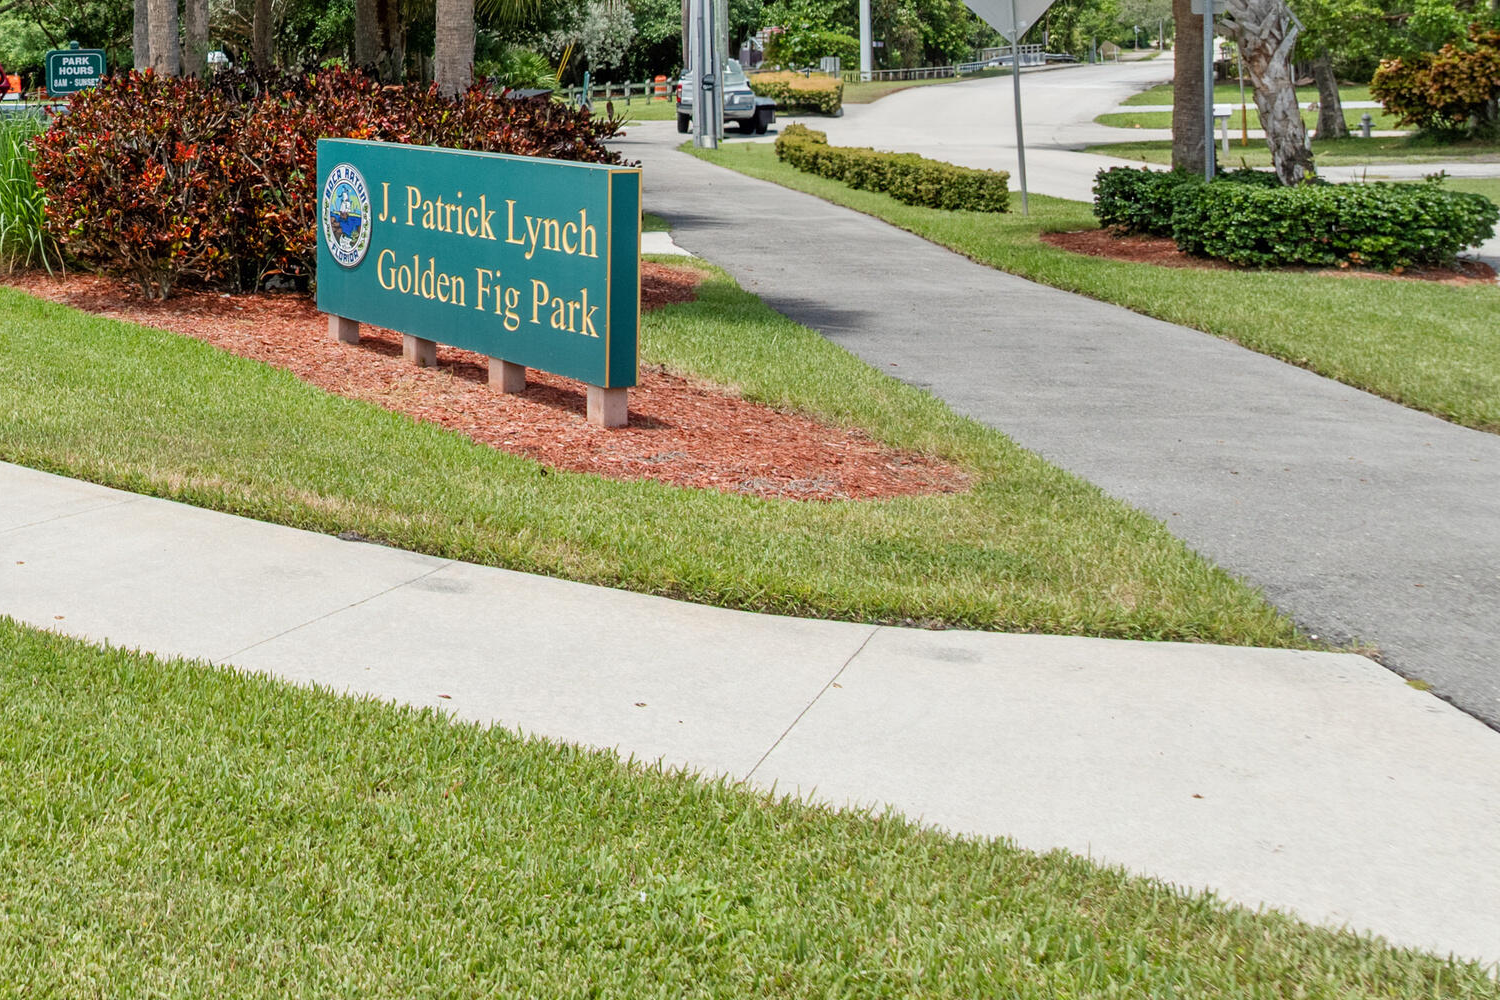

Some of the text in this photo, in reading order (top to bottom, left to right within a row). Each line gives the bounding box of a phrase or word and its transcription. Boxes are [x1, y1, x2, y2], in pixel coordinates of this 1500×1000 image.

[59, 66, 94, 75] HOURS
[62, 56, 89, 65] PARK
[54, 79, 67, 87] 8AM
[74, 78, 99, 87] SUNSET
[325, 168, 367, 203] BOCA RATON
[378, 182, 599, 260] J. Patrick Lynch
[331, 243, 359, 263] FLORIDA
[377, 248, 600, 338] Golden Fig Park
